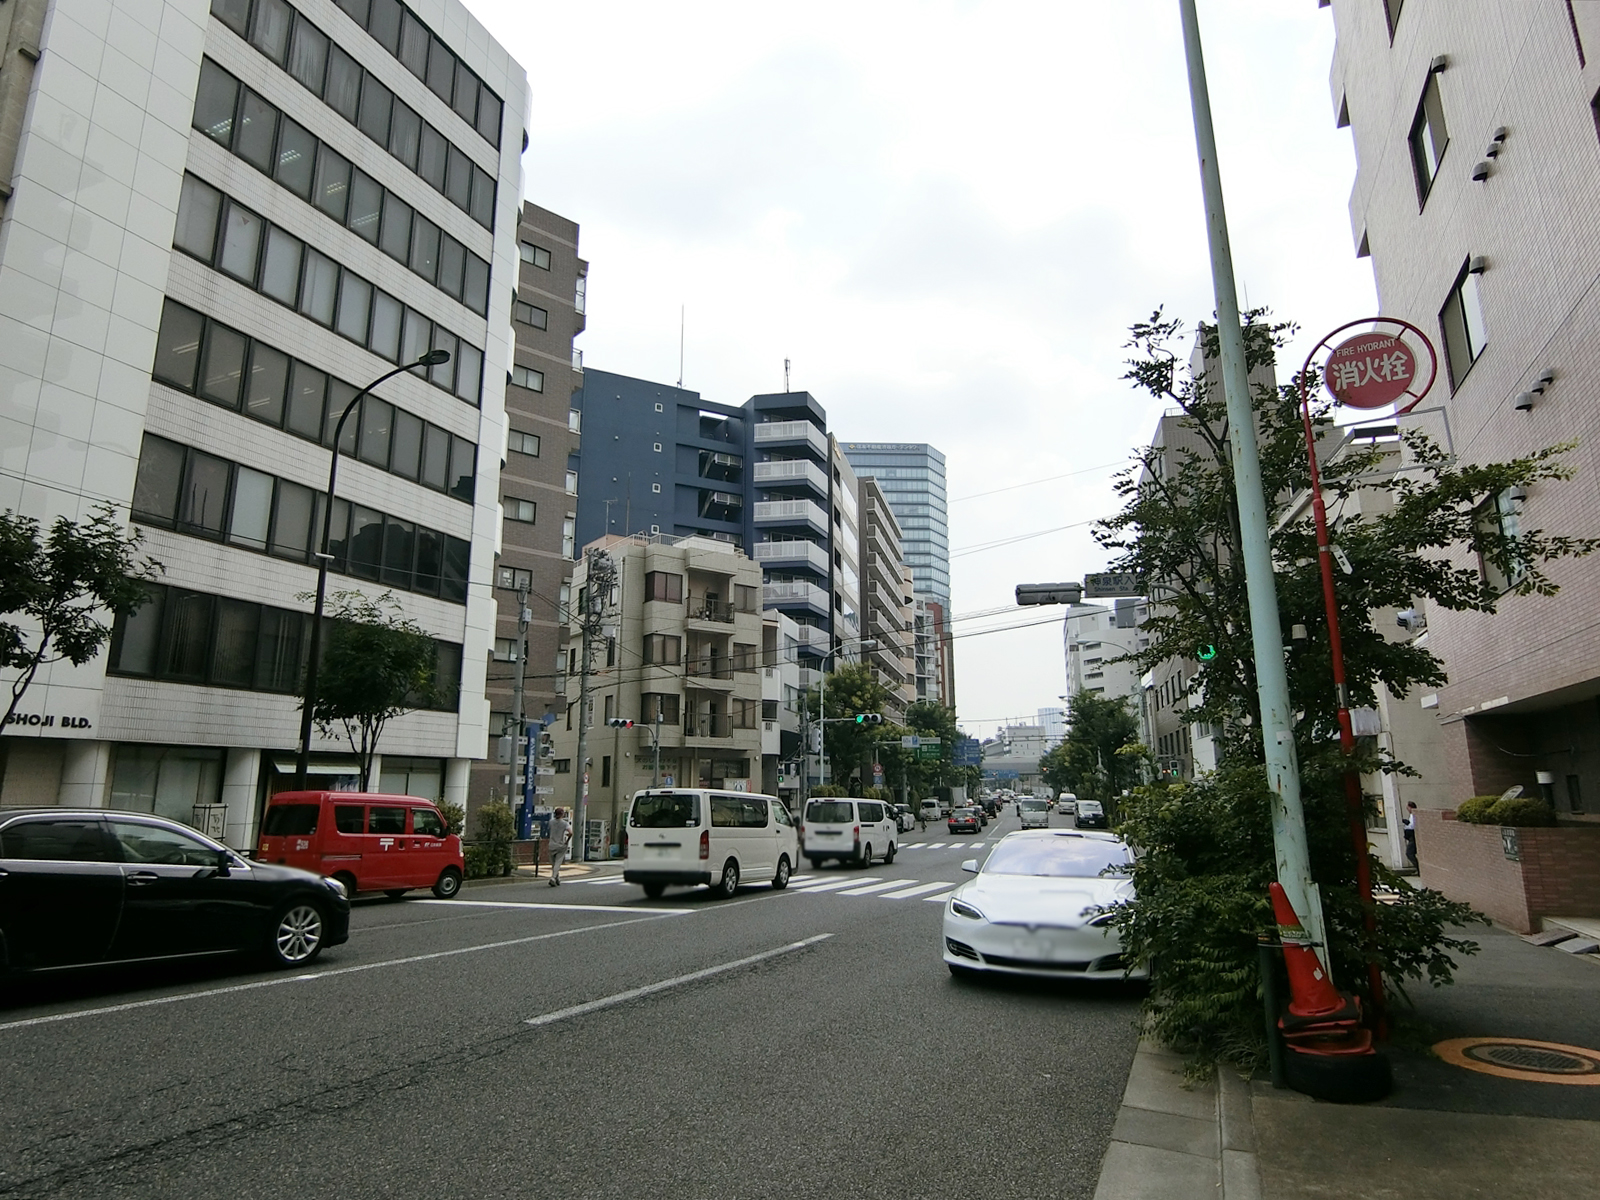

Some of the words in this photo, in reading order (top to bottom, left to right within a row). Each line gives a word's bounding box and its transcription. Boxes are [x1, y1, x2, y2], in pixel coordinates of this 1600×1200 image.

[1336, 346, 1355, 358] FIRE
[1357, 338, 1396, 354] HYDRANT
[1332, 350, 1410, 391] 消火栓
[6, 713, 55, 727] SHOJI
[61, 716, 92, 729] BLD.
